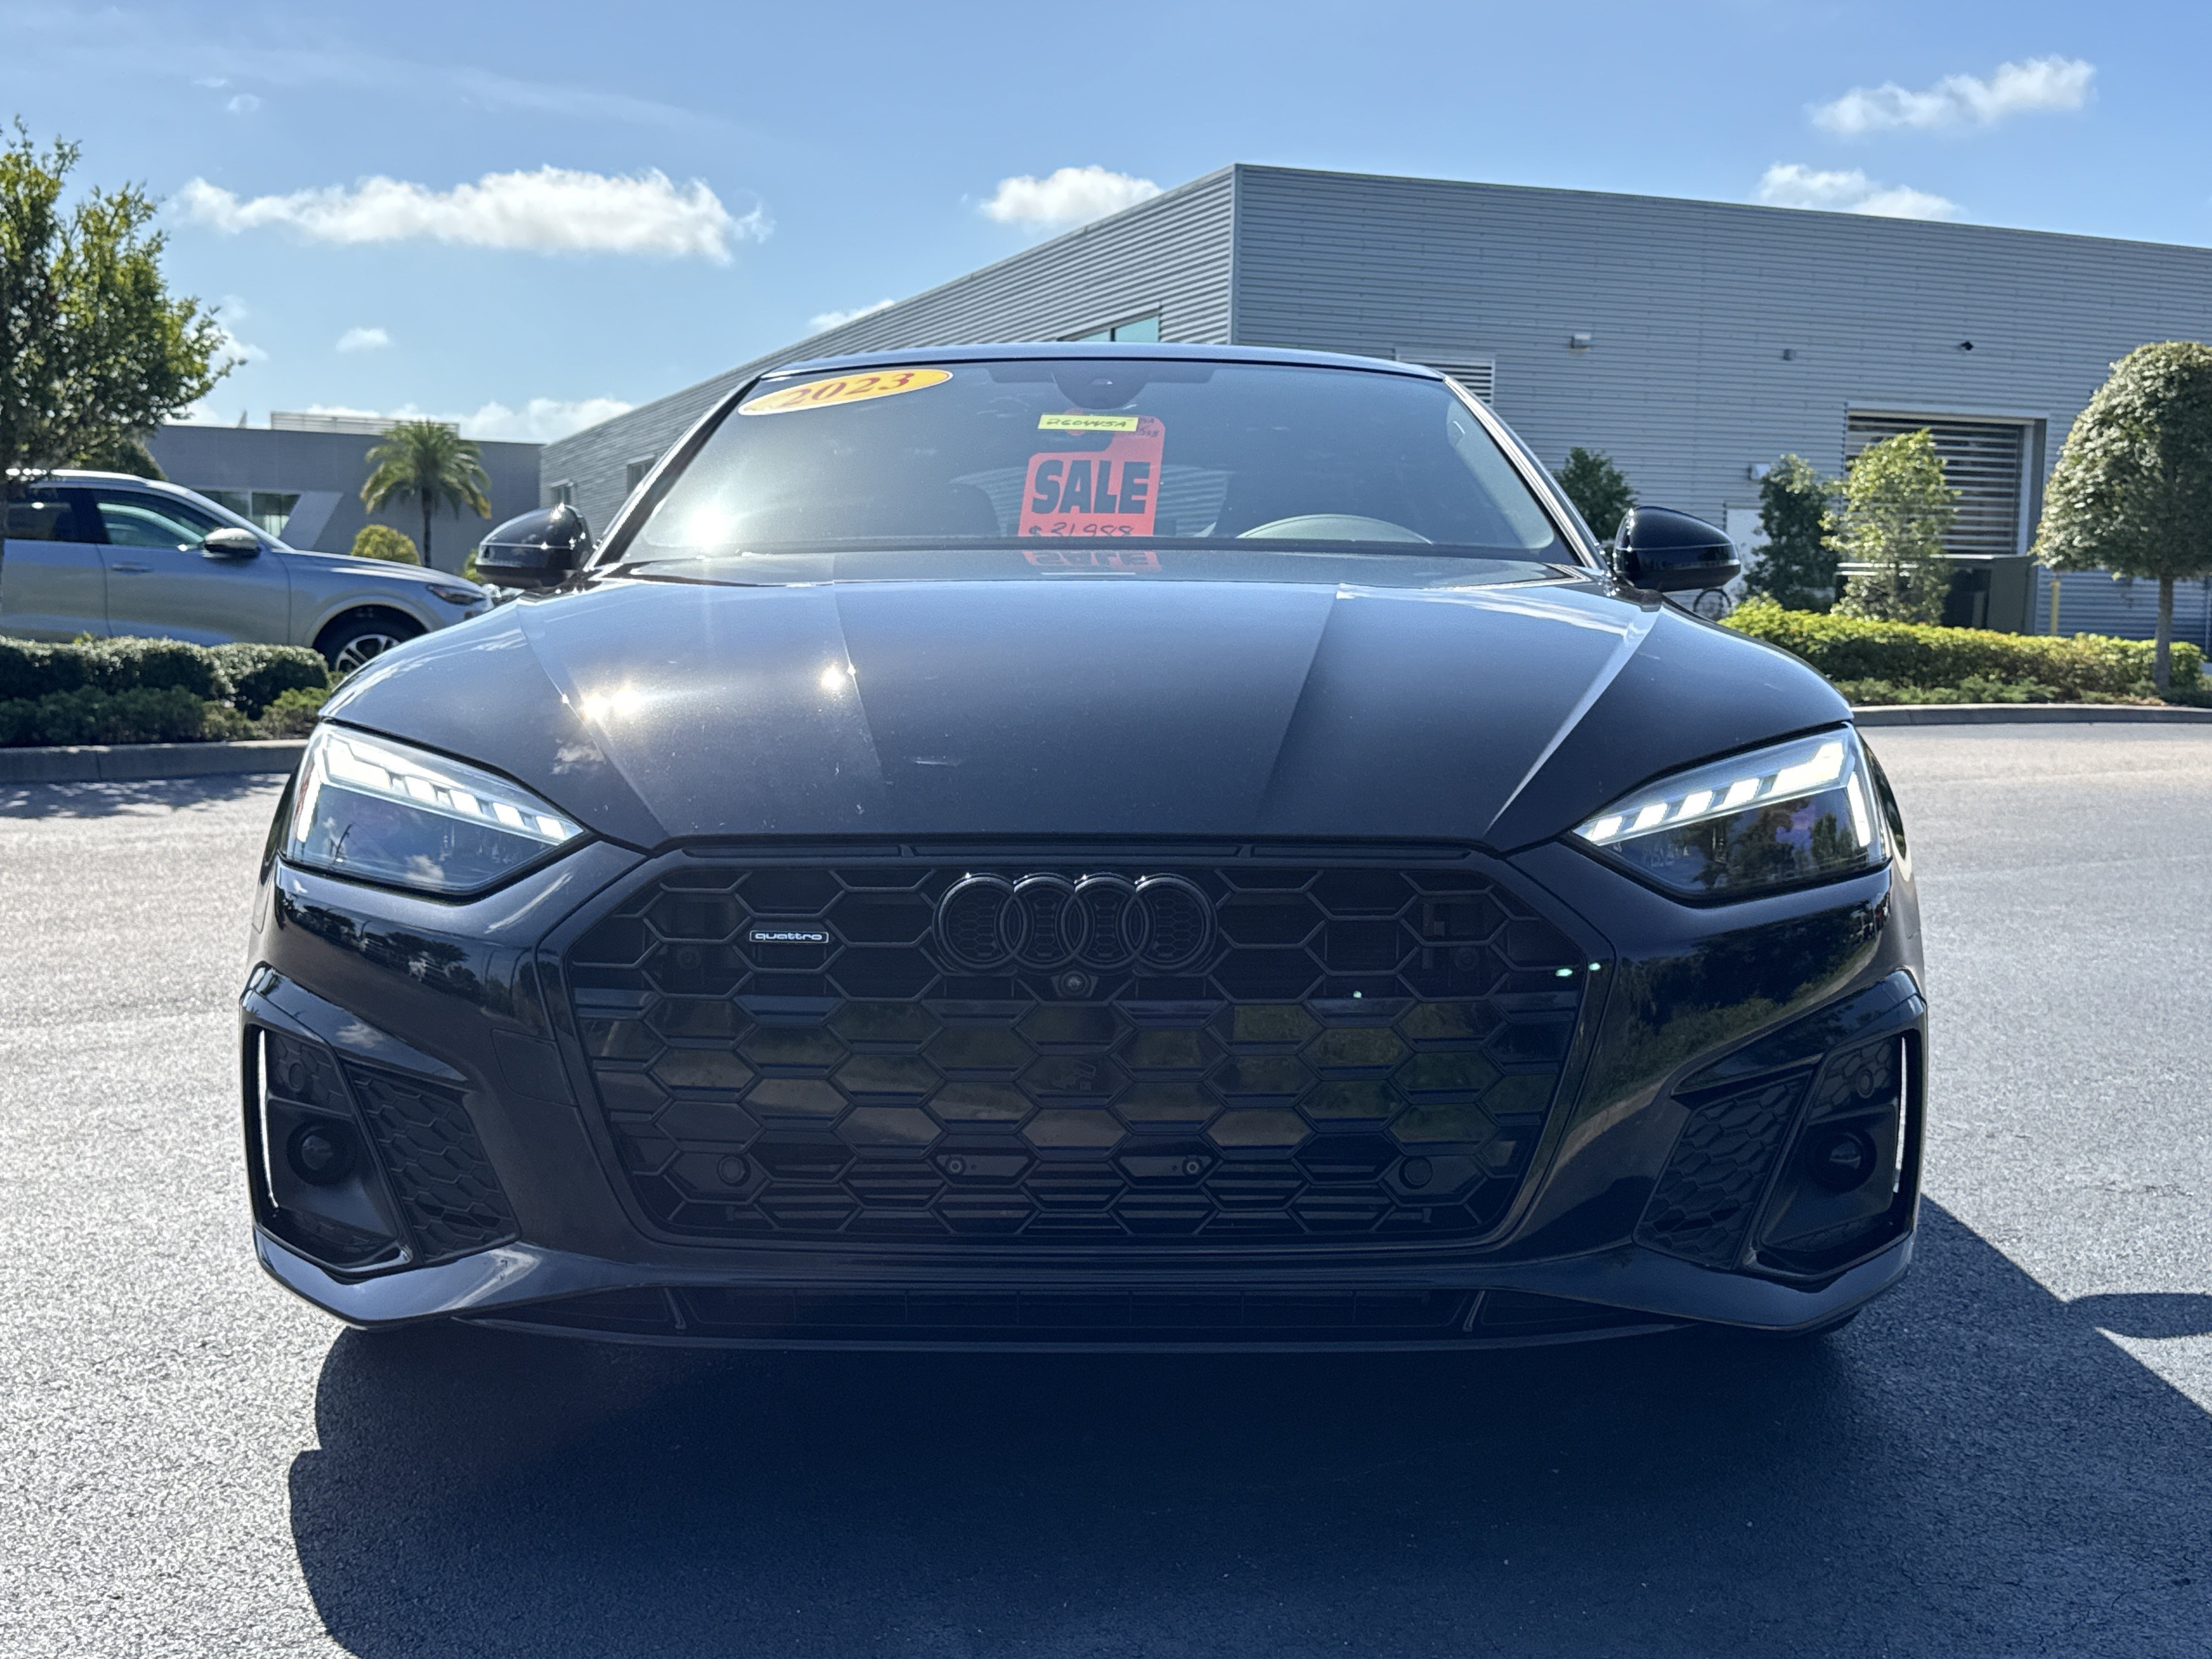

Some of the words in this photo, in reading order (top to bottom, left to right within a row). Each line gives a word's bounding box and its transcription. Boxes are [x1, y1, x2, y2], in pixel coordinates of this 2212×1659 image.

[780, 373, 916, 407] 2023
[1031, 459, 1150, 514] SALE
[755, 933, 822, 941] quattro
